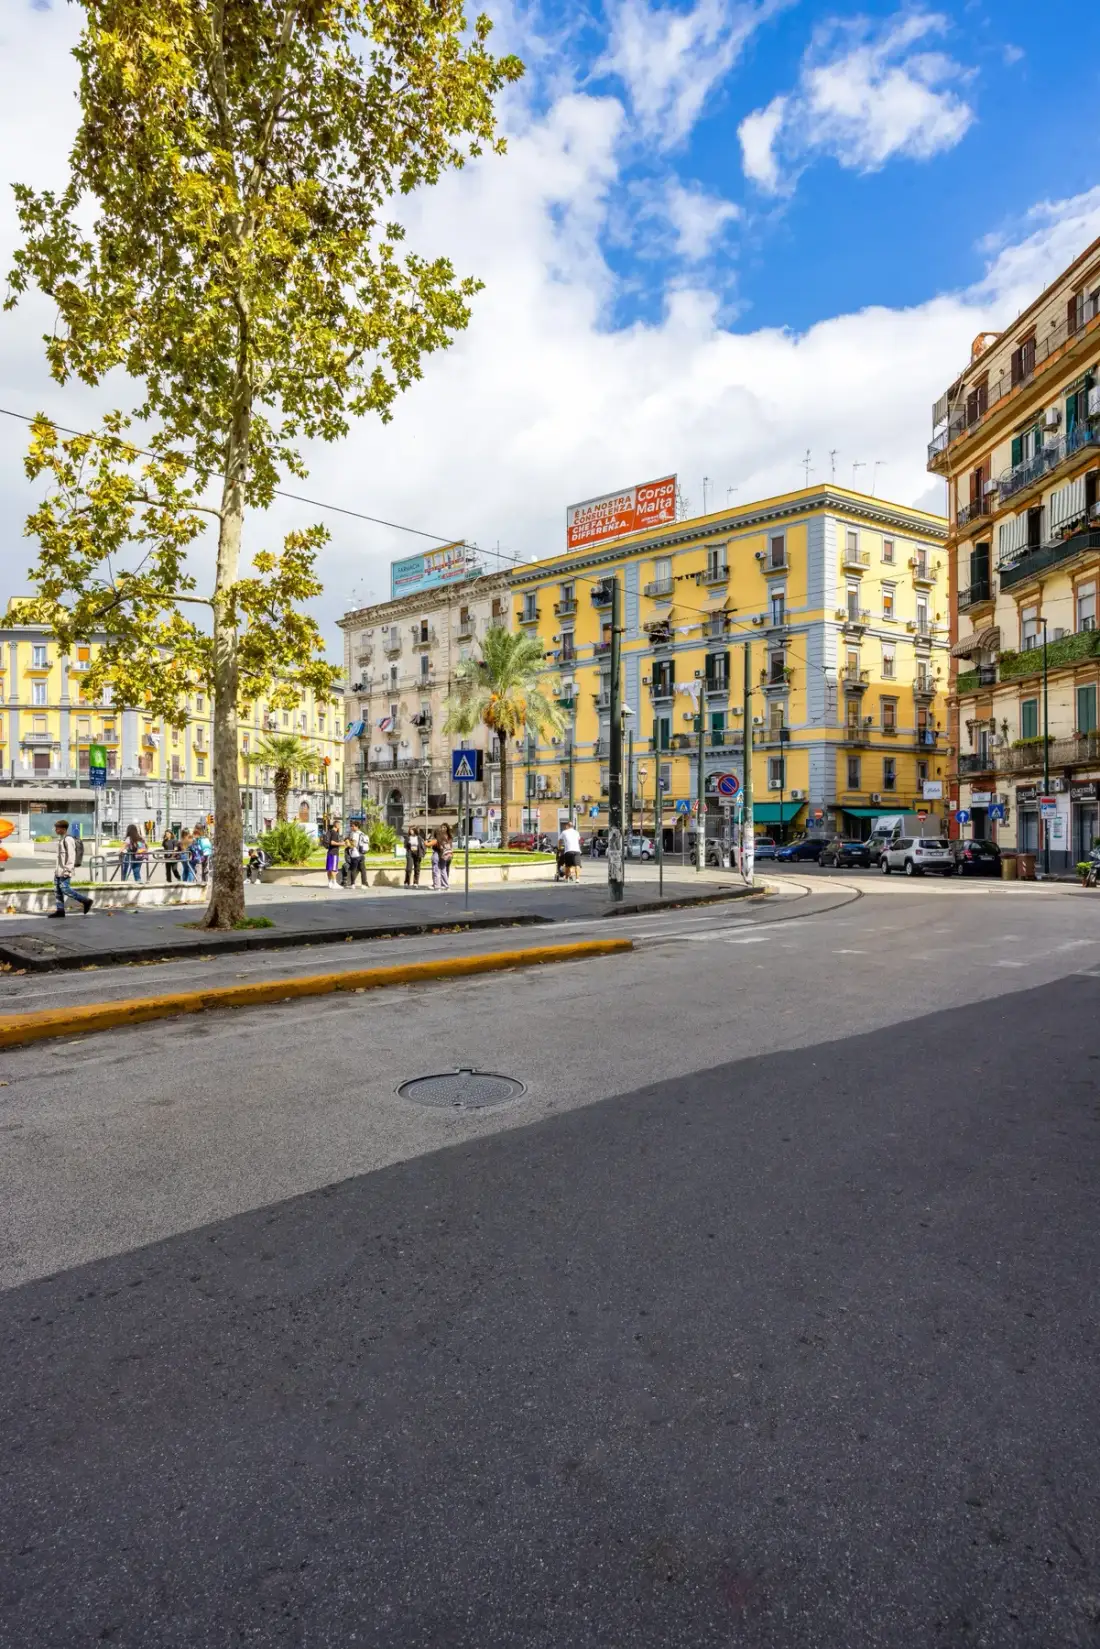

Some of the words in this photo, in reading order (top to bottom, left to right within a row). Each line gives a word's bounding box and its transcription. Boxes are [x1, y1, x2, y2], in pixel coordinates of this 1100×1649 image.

[637, 484, 674, 502] Corso
[573, 503, 633, 525] CONSULENZA
[582, 507, 593, 515] LA
[595, 496, 631, 510] NOSTRA
[636, 497, 672, 516] Malta
[572, 523, 590, 534] CHE
[591, 520, 603, 529] FA
[605, 516, 617, 525] LA
[572, 520, 629, 541] DIFFERENZA.
